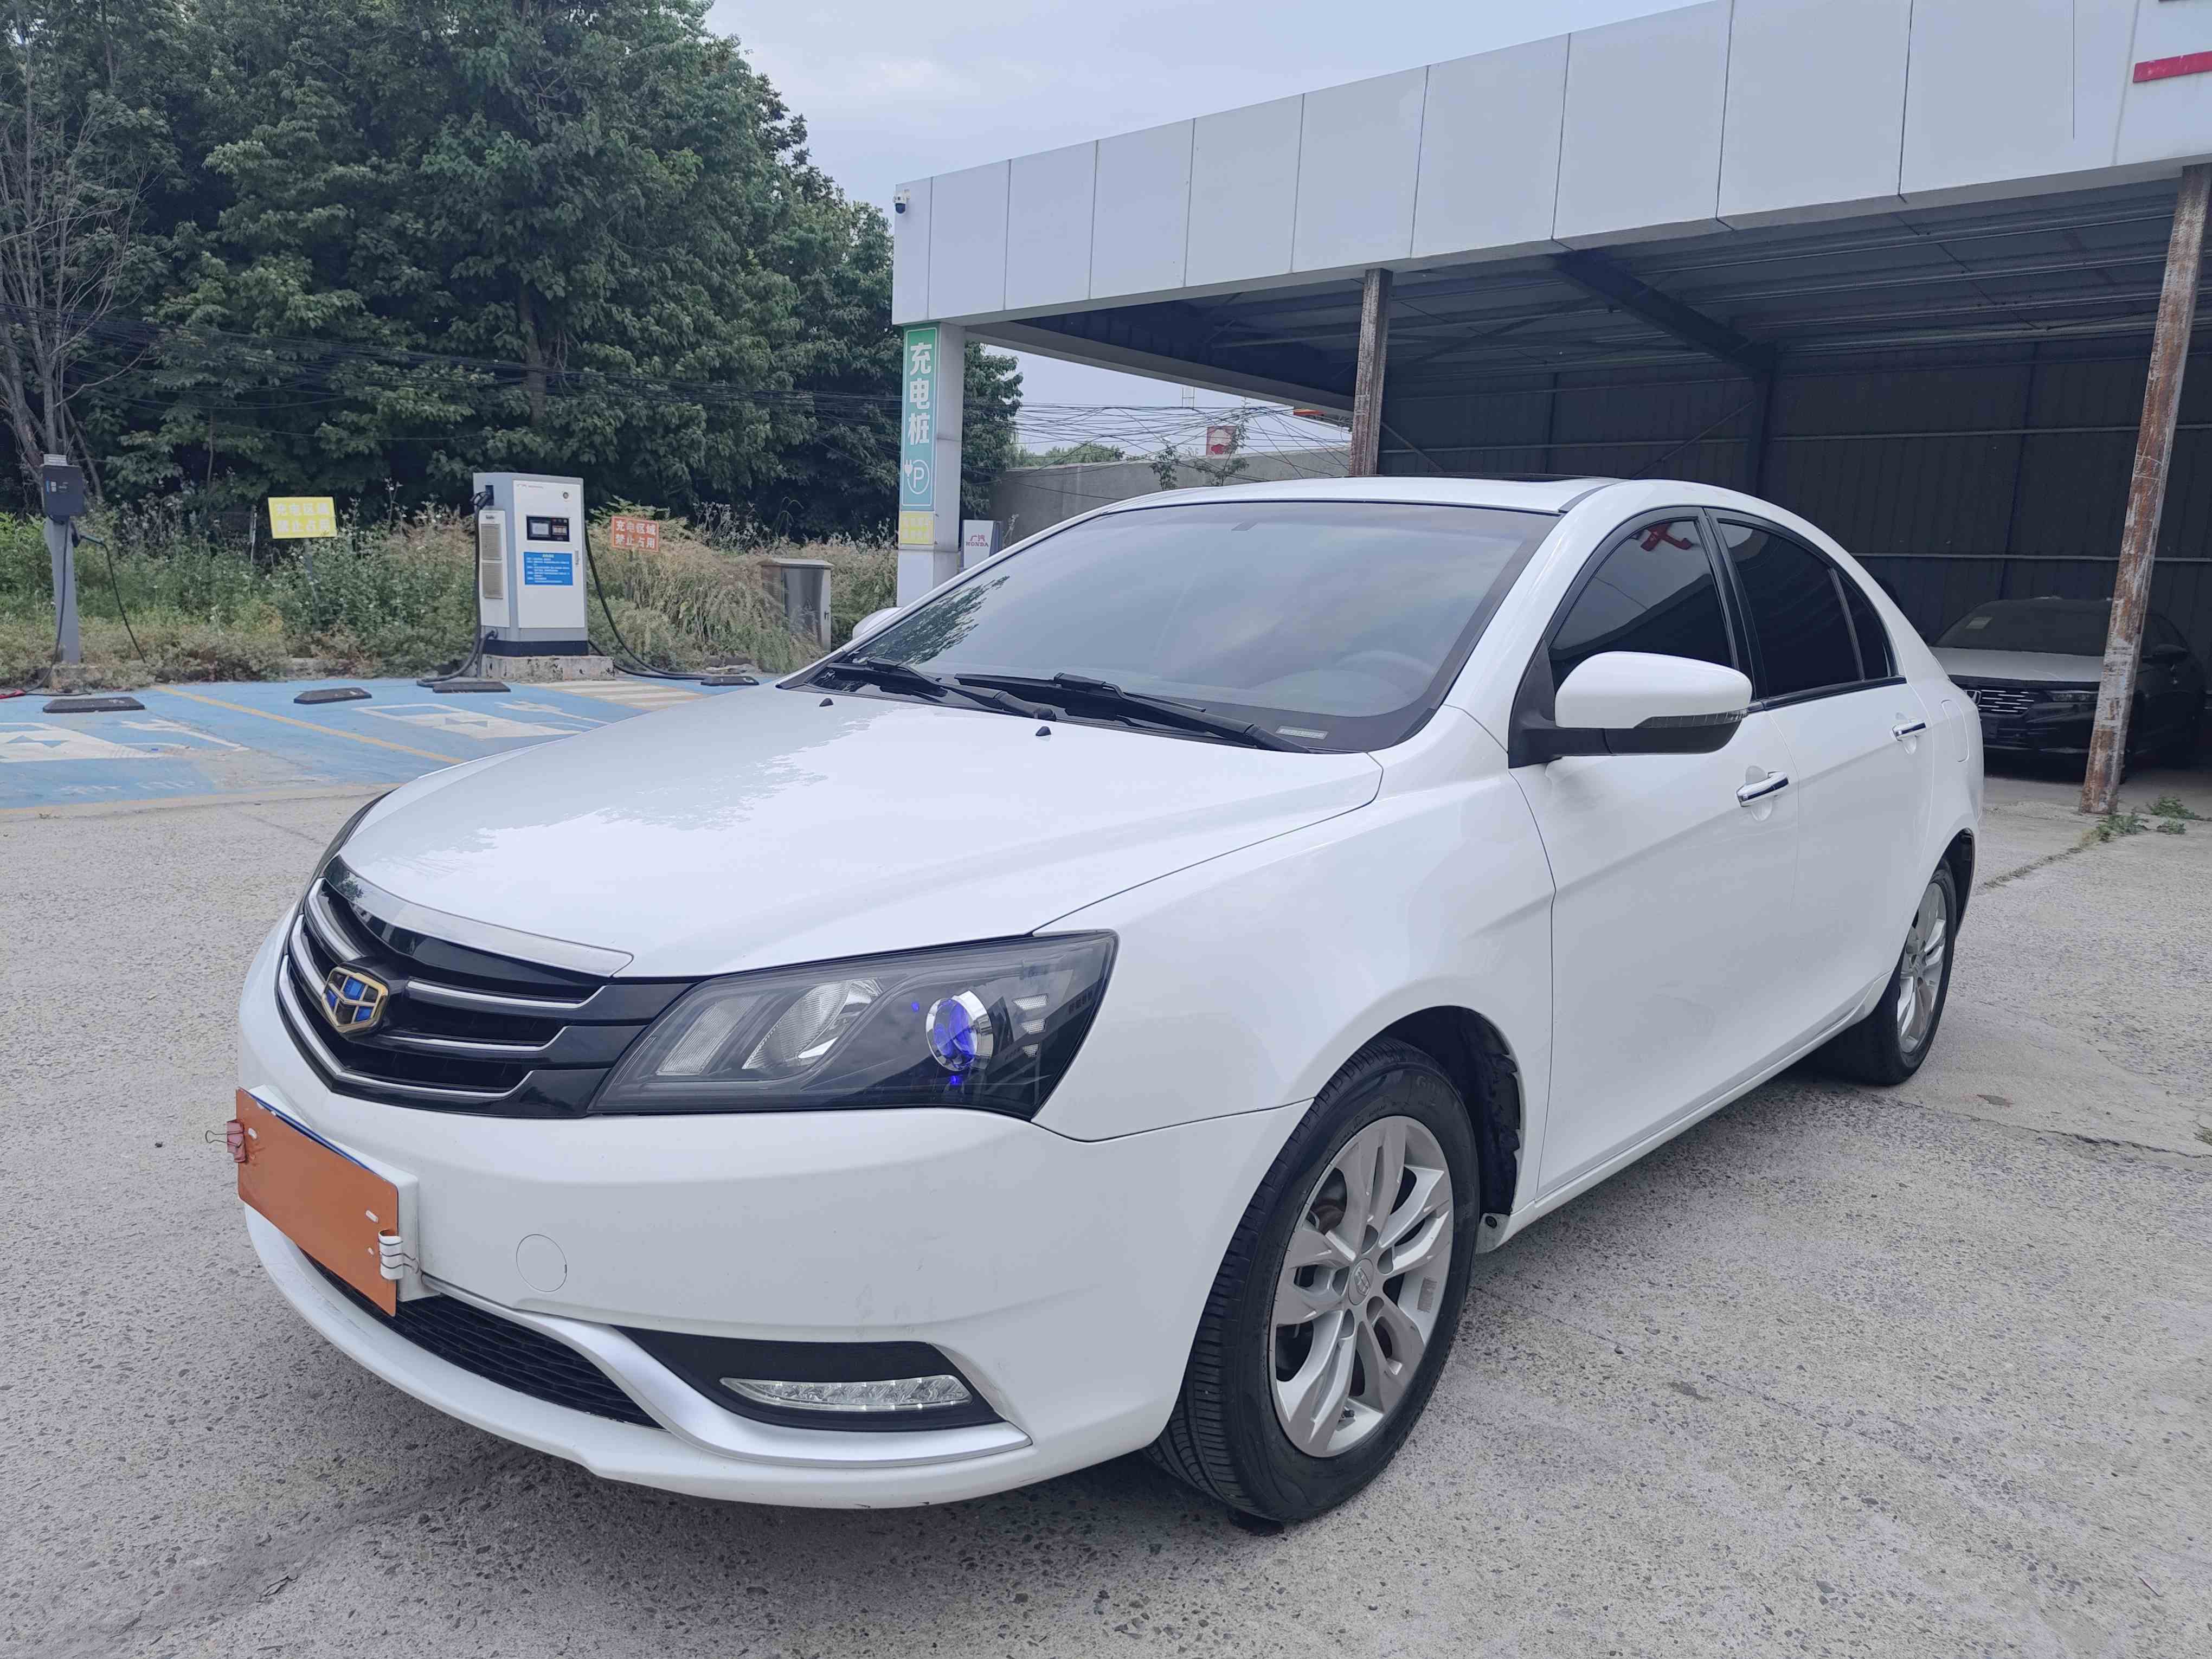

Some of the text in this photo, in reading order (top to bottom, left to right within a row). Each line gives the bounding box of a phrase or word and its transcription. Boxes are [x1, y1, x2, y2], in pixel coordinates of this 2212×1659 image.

[907, 342, 932, 446] 充电桩
[913, 467, 925, 488] P
[615, 520, 655, 536] 充电区域
[615, 533, 655, 548] 禁止占用
